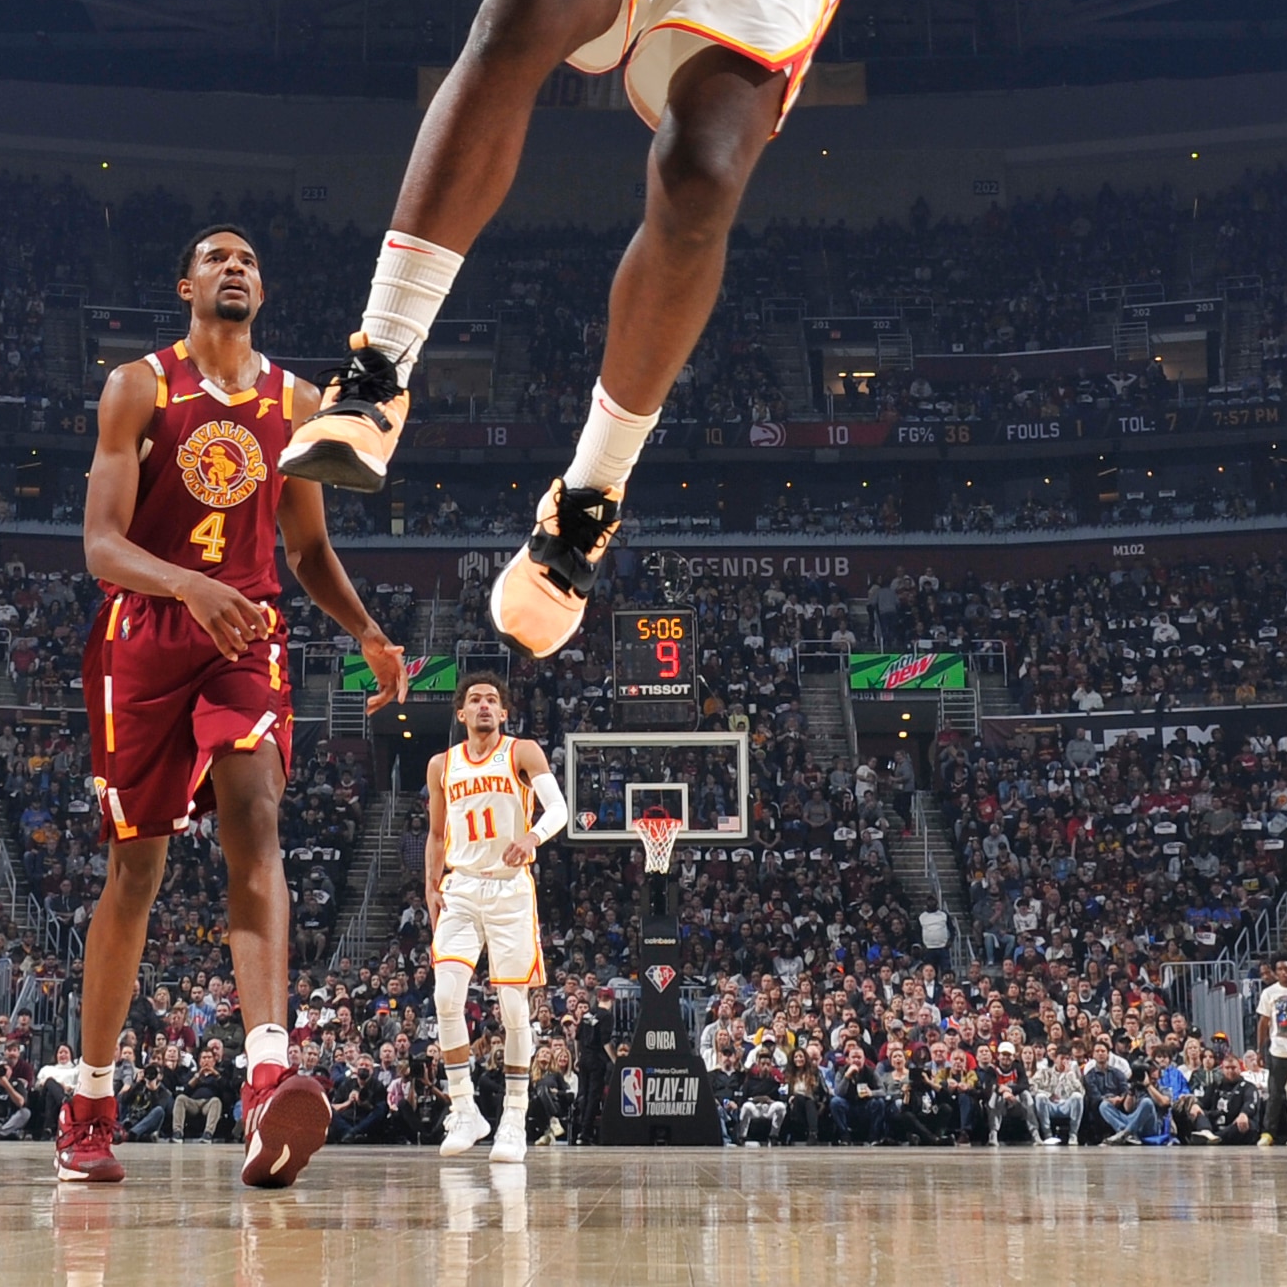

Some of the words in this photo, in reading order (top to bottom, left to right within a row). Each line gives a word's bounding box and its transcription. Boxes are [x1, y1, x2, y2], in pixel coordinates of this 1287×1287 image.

[470, 323, 488, 333] 201
[1119, 416, 1157, 433] TOL:
[1215, 409, 1250, 426] 7:57
[1254, 407, 1279, 423] PM
[485, 426, 507, 446] 18
[827, 425, 849, 445] 10
[898, 426, 935, 443] FG%
[945, 426, 970, 443] 36
[1006, 422, 1060, 440] FOULS
[177, 420, 267, 482] CAVALIERS
[182, 468, 257, 507] CLEVELAND
[189, 512, 226, 563] 4
[1114, 543, 1145, 556] M102
[783, 556, 850, 577] CLUB
[637, 617, 683, 640] 5:06
[656, 640, 680, 678] 9
[638, 684, 691, 695] TISSOT
[448, 776, 514, 803] ATLANTA
[465, 805, 497, 843] 11
[643, 937, 677, 945] coinbase
[645, 1030, 676, 1051] @NBA
[645, 1077, 699, 1102] PLAY-IN
[645, 1101, 698, 1116] TOURNAMENT
